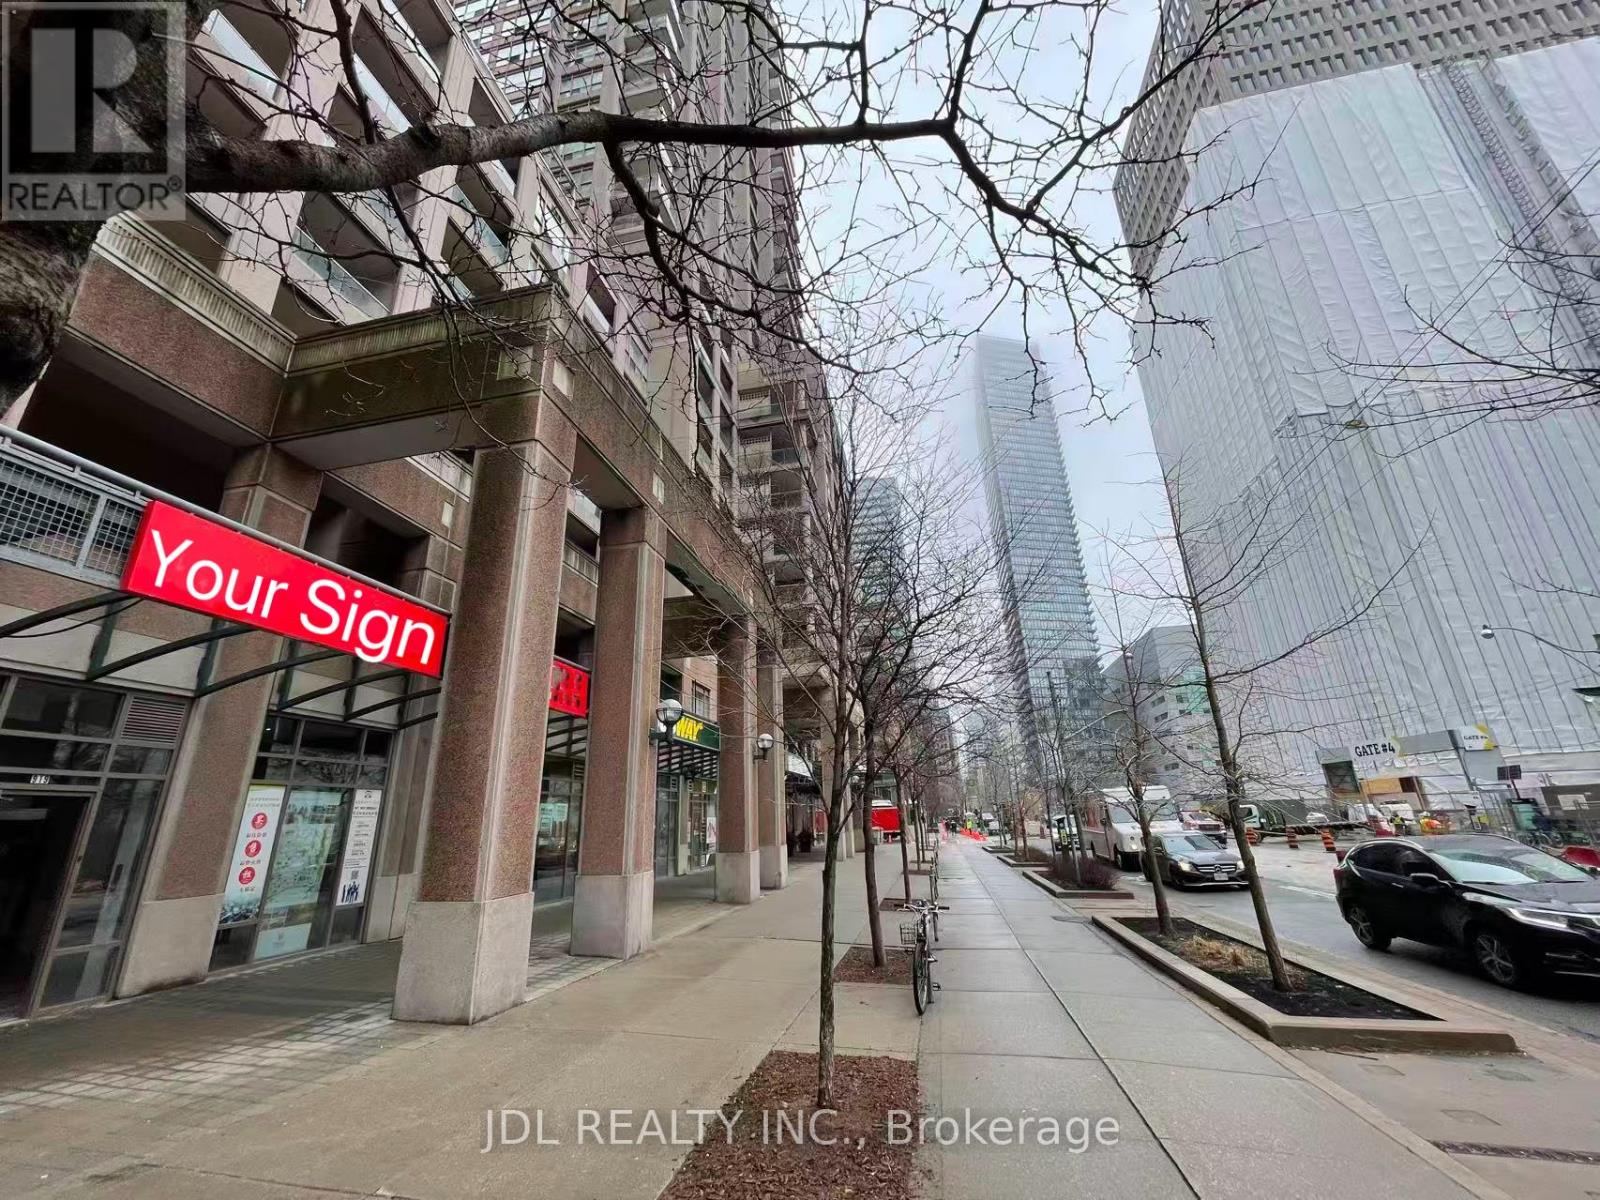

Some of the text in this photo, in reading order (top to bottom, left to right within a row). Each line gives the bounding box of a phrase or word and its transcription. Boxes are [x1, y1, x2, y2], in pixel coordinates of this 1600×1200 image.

[150, 529, 436, 665] Your Sign
[1354, 742, 1396, 758] GATE #4
